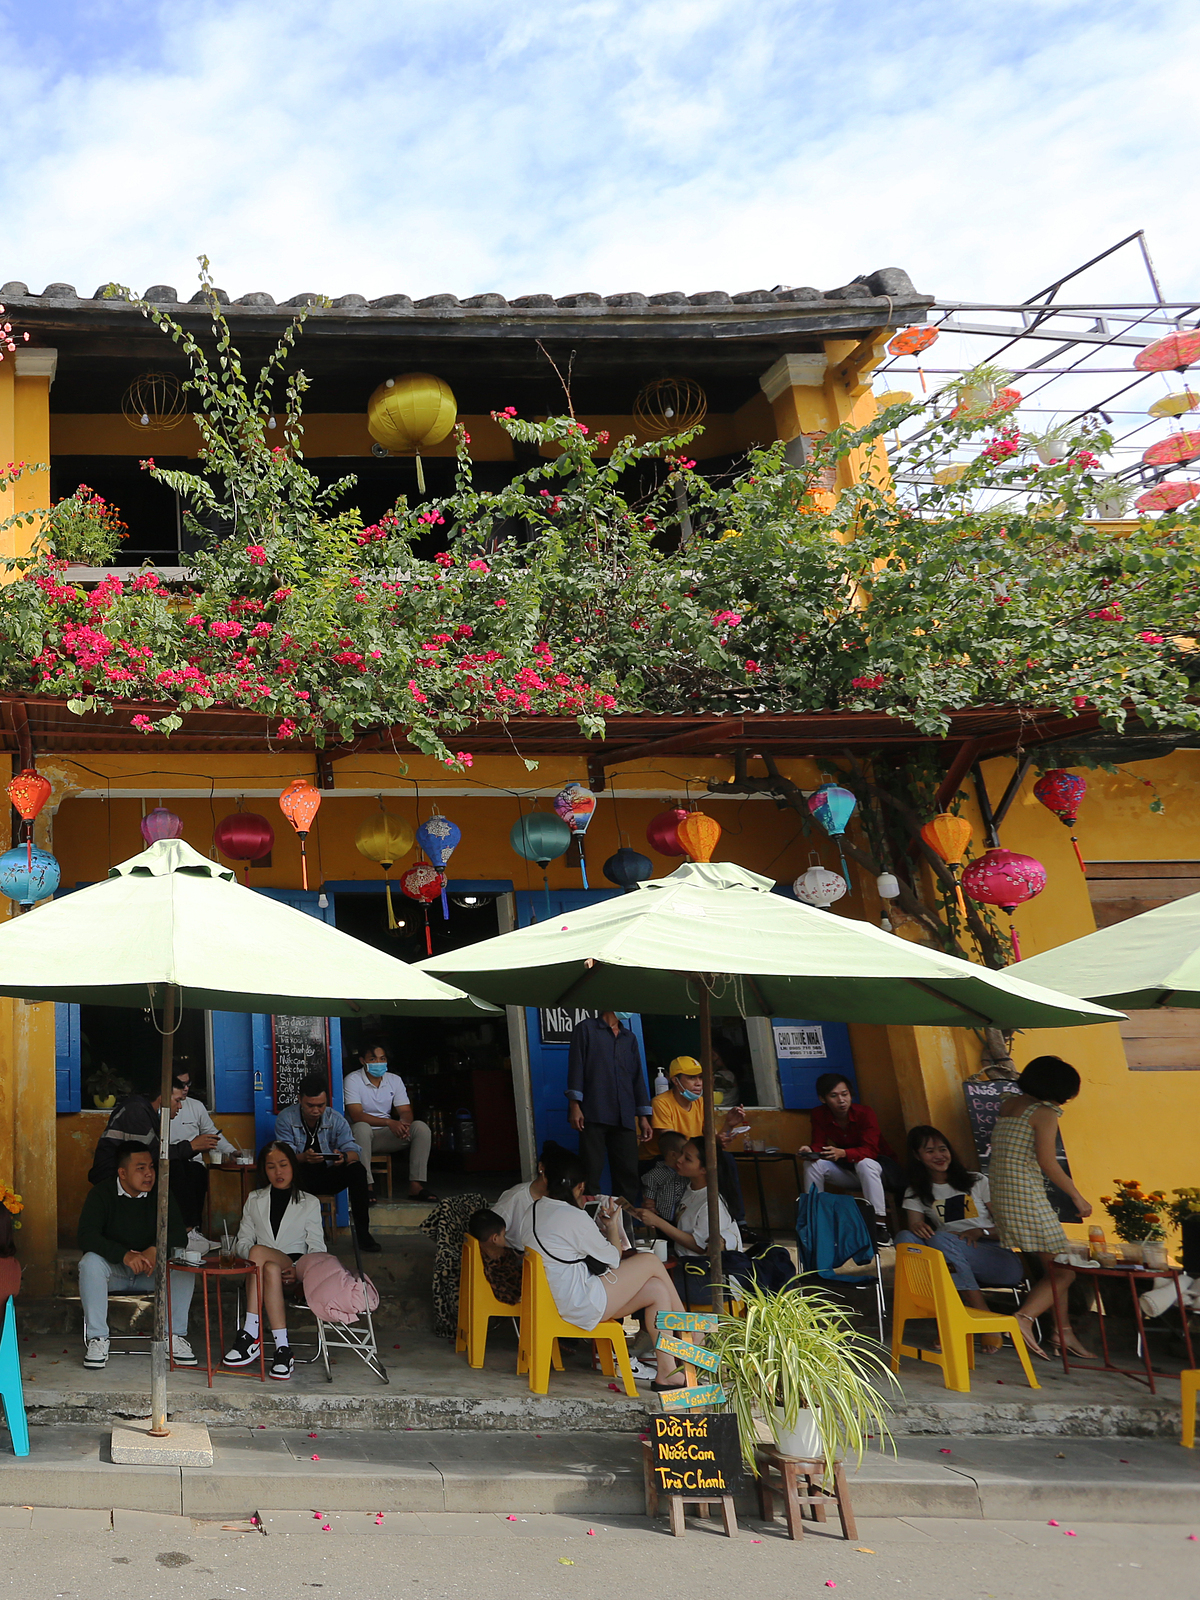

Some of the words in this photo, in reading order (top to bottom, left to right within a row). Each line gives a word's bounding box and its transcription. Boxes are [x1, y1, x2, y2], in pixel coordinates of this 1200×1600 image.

[545, 1006, 573, 1032] Nhà
[778, 1032, 791, 1046] CHO
[655, 1415, 683, 1437] Dừa
[682, 1417, 708, 1438] trái
[658, 1439, 688, 1461] Nước
[687, 1444, 716, 1461] Cam
[654, 1466, 683, 1490] Trà
[683, 1468, 727, 1490] Chanh
